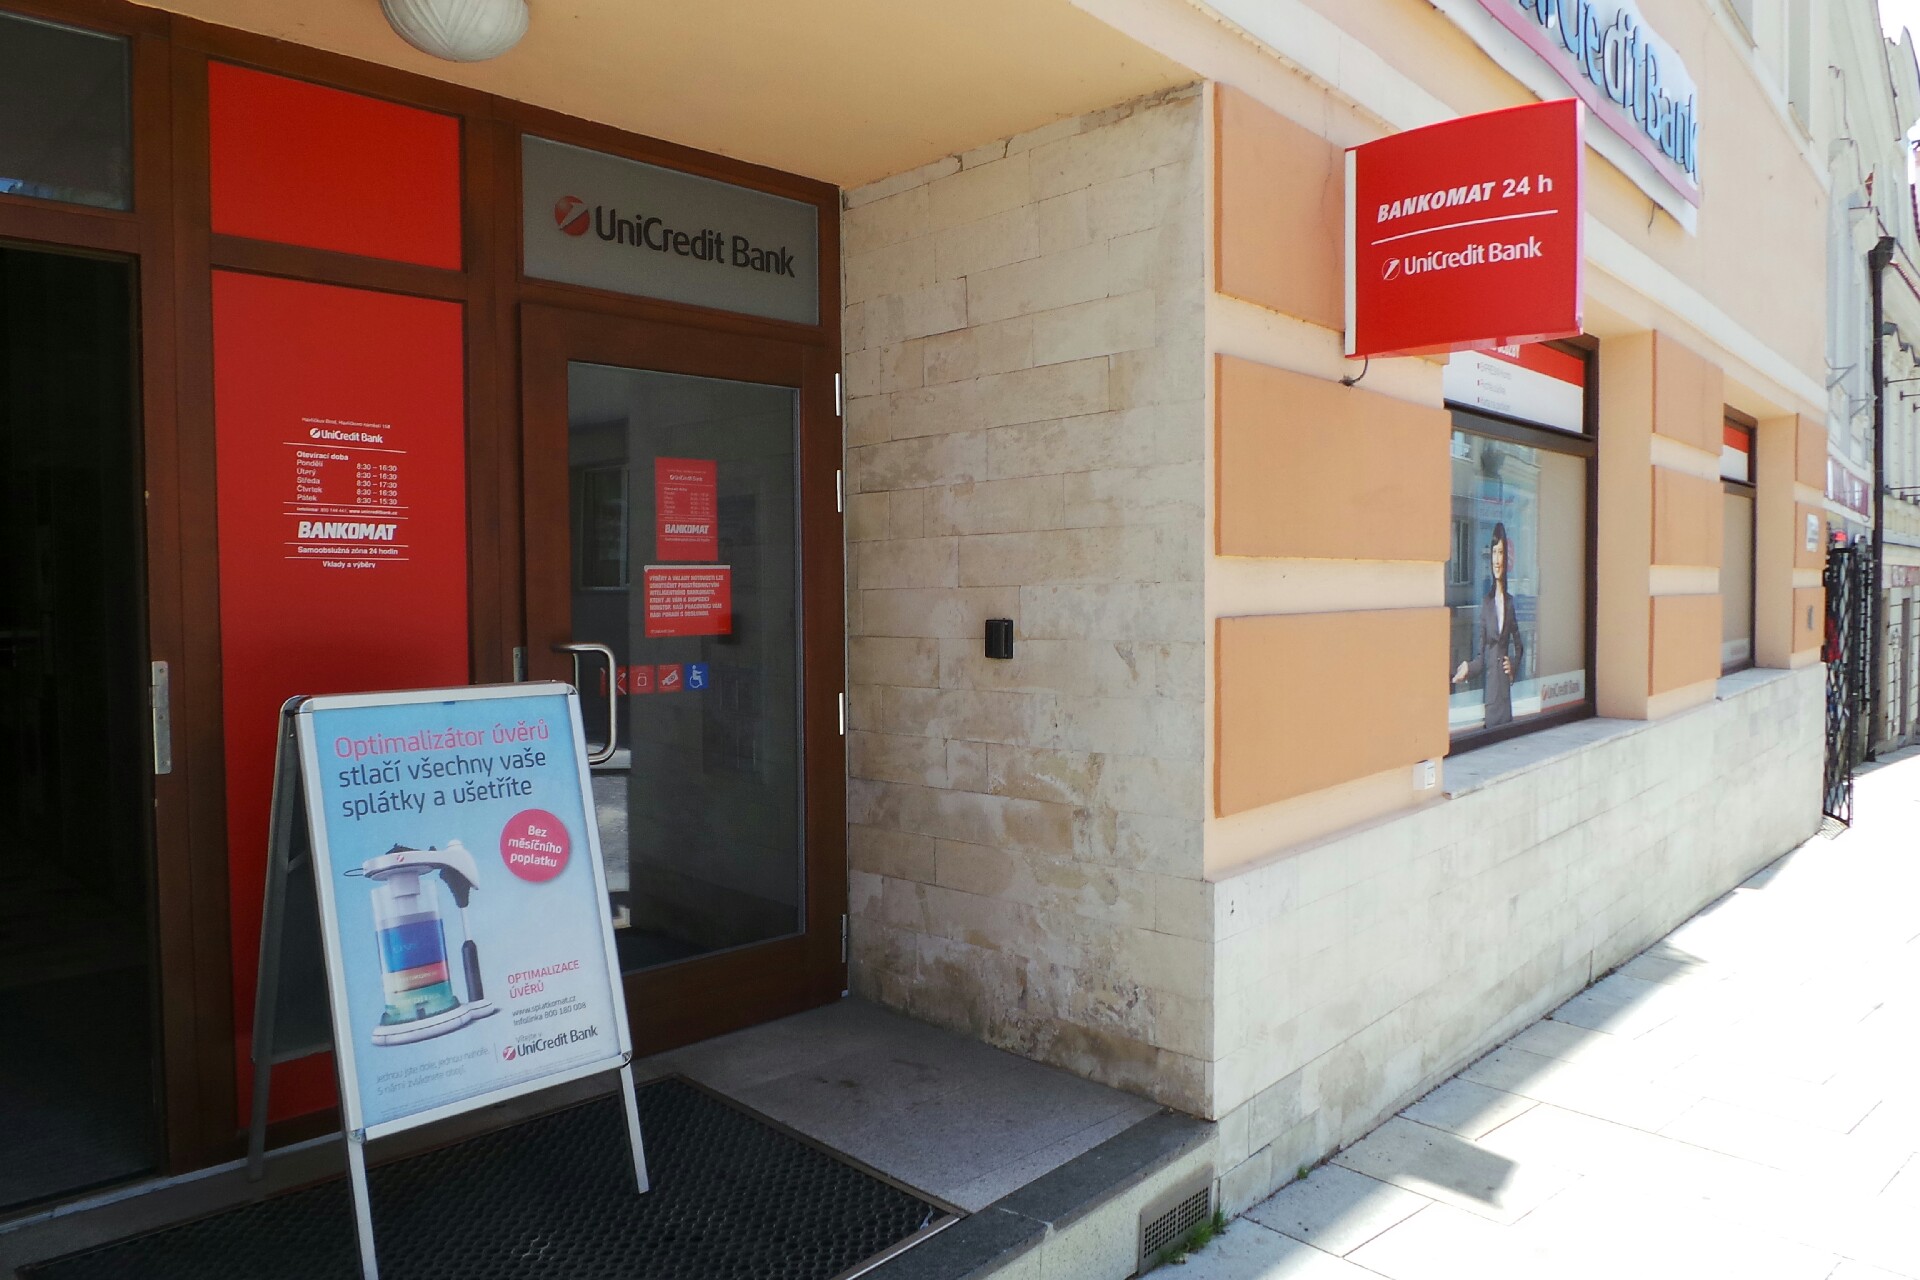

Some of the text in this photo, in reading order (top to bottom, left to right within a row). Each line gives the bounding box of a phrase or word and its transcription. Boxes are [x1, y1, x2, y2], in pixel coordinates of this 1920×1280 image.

[1645, 43, 1699, 187] Bank
[1377, 174, 1553, 224] BANKOMAT 24 h
[595, 205, 795, 278] UniCredit Bank
[1404, 236, 1543, 275] UniCredit Bank
[321, 429, 383, 443] UniCredit Bank
[330, 452, 349, 461] doba
[356, 462, 371, 471] 8:30
[379, 463, 398, 472] 16:30
[356, 471, 371, 479] 8:30
[296, 476, 321, 485] Středa
[356, 479, 371, 487] 8:30
[379, 481, 398, 489] 17:30
[296, 484, 322, 493] Čtvrtek
[356, 488, 371, 496] 8:30
[296, 493, 317, 501] Pátek
[297, 521, 398, 541] BANKOMAT
[664, 523, 709, 534] BANKOMAT
[297, 545, 350, 555] Samoobslužná
[351, 547, 367, 555] zóna
[368, 547, 377, 555] 24
[322, 560, 346, 569] Vklady
[353, 560, 376, 569] výběry
[334, 718, 549, 761] Optimalizátor úvěrů
[338, 747, 546, 788] stlačí všechny vaše
[342, 777, 533, 821] splátky a ušetříte
[528, 825, 547, 837] Bez
[508, 837, 562, 854] měsíčního
[510, 853, 557, 868] poplatku
[507, 959, 580, 985] OPTIMALIZACE
[509, 980, 544, 999] ÚVĚRŮ
[512, 995, 576, 1017] www.splatkomat.cz
[513, 1012, 543, 1026] Infolinka
[544, 1009, 558, 1019] 800
[559, 1005, 572, 1015] 180
[517, 1024, 598, 1057] UniCredit Bank
